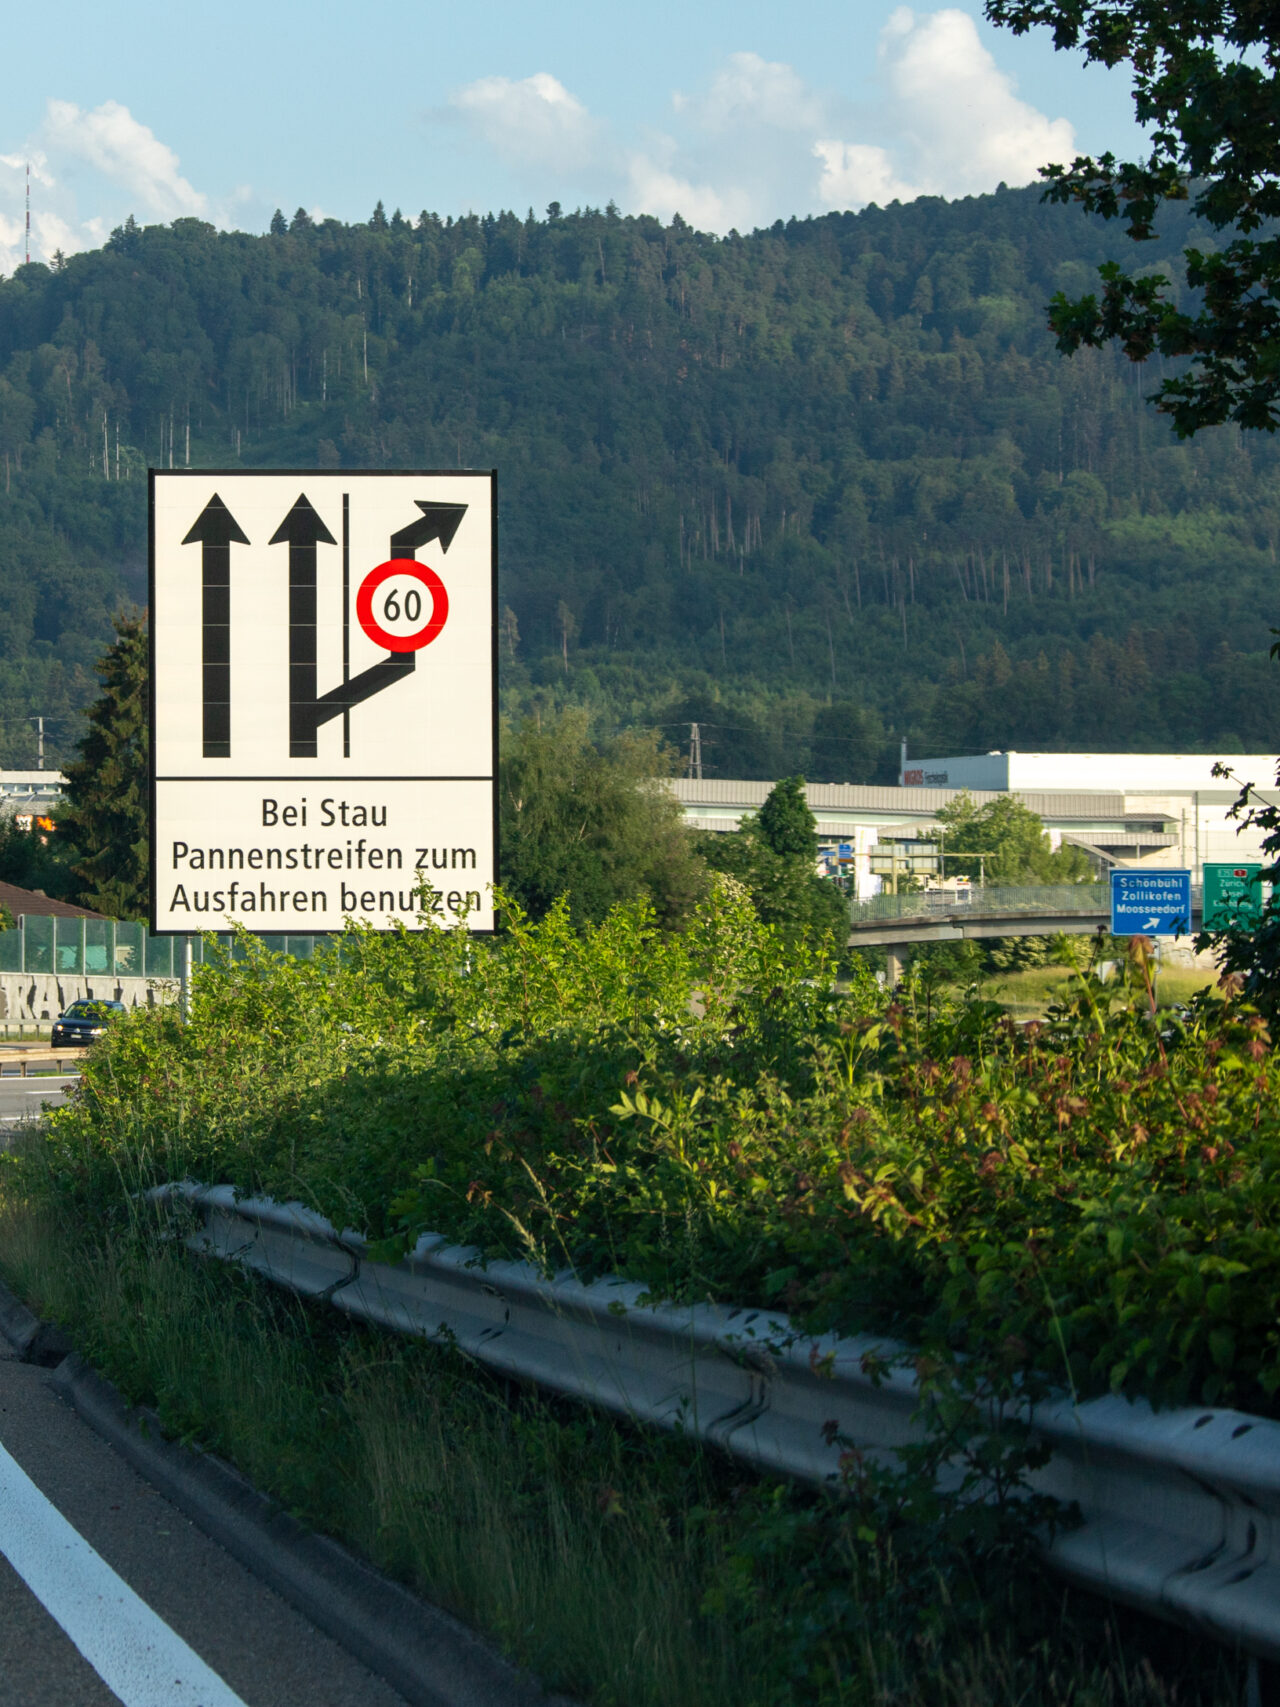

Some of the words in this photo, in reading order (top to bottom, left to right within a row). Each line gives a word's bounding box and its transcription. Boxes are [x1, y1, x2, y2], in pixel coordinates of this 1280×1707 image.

[383, 588, 422, 622] 60
[262, 798, 307, 827] Bei
[320, 798, 387, 827] Stau
[173, 839, 402, 869] Pannenstreifen
[415, 848, 476, 869] zum
[169, 881, 327, 911] Ausfahren
[1120, 878, 1183, 888] Schönbühl
[1121, 890, 1182, 901] Zollikofen
[1116, 903, 1186, 914] Moosseedorf
